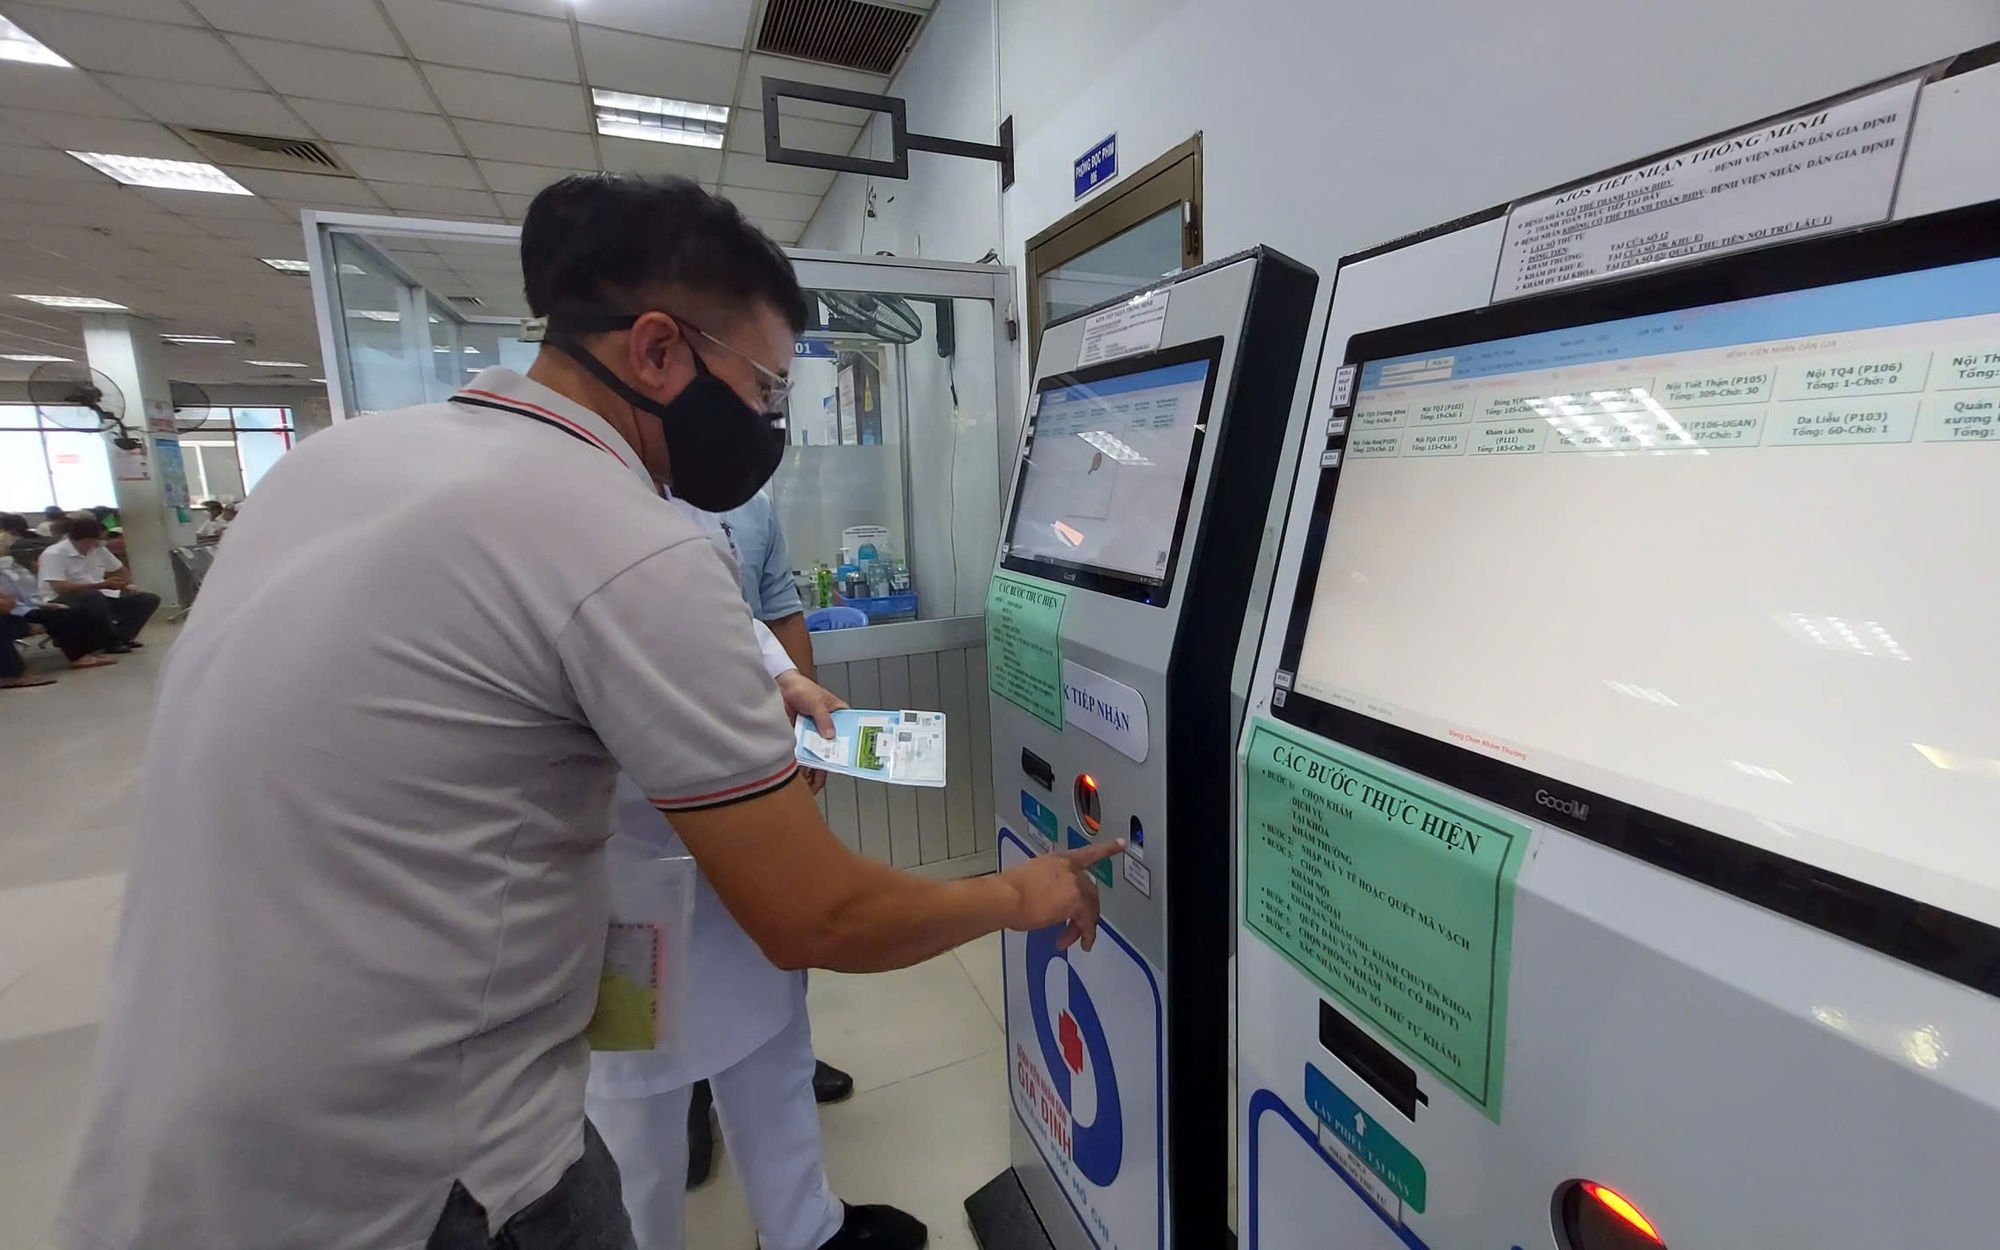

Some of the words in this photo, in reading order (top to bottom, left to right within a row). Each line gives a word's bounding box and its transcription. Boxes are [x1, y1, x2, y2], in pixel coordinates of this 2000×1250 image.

[1745, 150, 1770, 165] VIỆN
[1772, 139, 1805, 156] NHÂN
[1808, 131, 1834, 146] DÂN
[1836, 124, 1859, 138] GIA
[1555, 185, 1591, 206] KIOS
[1596, 172, 1632, 194] TIẾP
[1635, 158, 1683, 179] NHẬN
[1691, 134, 1762, 164] THÔNG
[1765, 113, 1829, 141] MINH
[1710, 180, 1739, 196] BỆNH
[1742, 172, 1767, 186] VIỆN
[1770, 162, 1802, 178] NHÂN
[1806, 155, 1833, 170] DÂN
[1834, 148, 1858, 162] GIA
[794, 342, 812, 354] 01
[1952, 356, 1978, 368] Nội
[1806, 370, 1826, 380] Nội
[1830, 367, 1854, 378] TQ4
[1858, 362, 1903, 376] (P106)
[1958, 368, 2000, 380] Tổng:
[1731, 374, 1768, 386] (P105)
[1806, 380, 1839, 391] Tổng:
[1843, 376, 1884, 388] 1-Chờ:
[1888, 374, 1897, 384] 0
[1670, 390, 1695, 401] Tổng:
[1746, 386, 1759, 395] 30
[1797, 416, 1812, 425] Da
[1816, 412, 1840, 424] Liễu
[1844, 412, 1888, 425] (P103)
[1735, 430, 1742, 439] 3
[1792, 426, 1824, 438] Tổng:
[1828, 425, 1876, 436] 60-Chờ:
[1881, 424, 1888, 434] 1
[1952, 426, 1994, 438] Tổng:
[1496, 436, 1518, 446] (P111)
[1069, 685, 1094, 712] TIẾP
[1096, 702, 1130, 732] NHẬN
[1272, 746, 1306, 773] CÁC
[1306, 760, 1358, 797] BƯỚC
[1361, 784, 1420, 826] THỰC
[1420, 812, 1482, 856] HIỆN
[1302, 787, 1325, 805] CHỌN
[1326, 799, 1353, 820] KHÁM
[1306, 818, 1330, 838] KHOA
[1300, 858, 1322, 878] CHỌN
[1442, 994, 1472, 1022] KHOA
[1018, 1061, 1036, 1106] GIA
